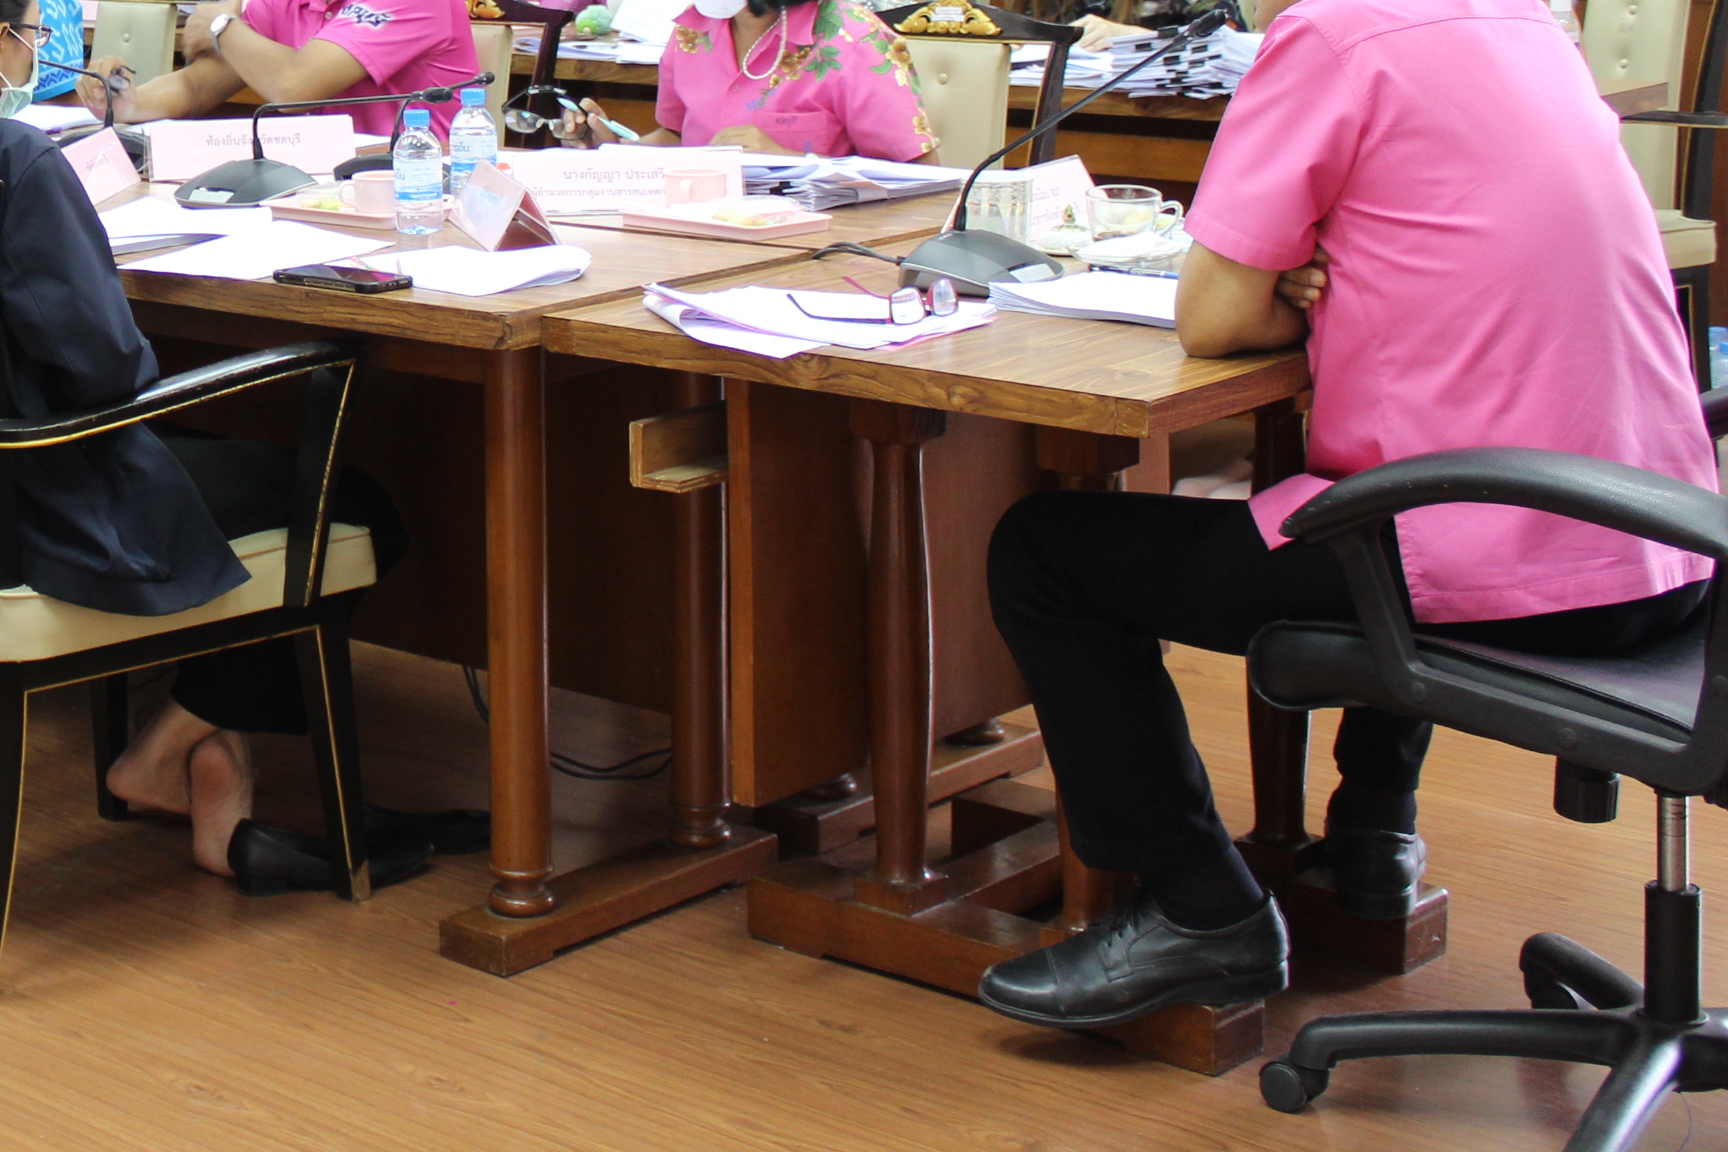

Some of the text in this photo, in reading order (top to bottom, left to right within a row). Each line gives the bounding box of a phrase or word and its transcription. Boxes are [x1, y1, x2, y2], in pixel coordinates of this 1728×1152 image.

[205, 132, 301, 148] ท้องถิ่นจังวัดชลบุรี
[626, 167, 665, 180] ประเสริ
